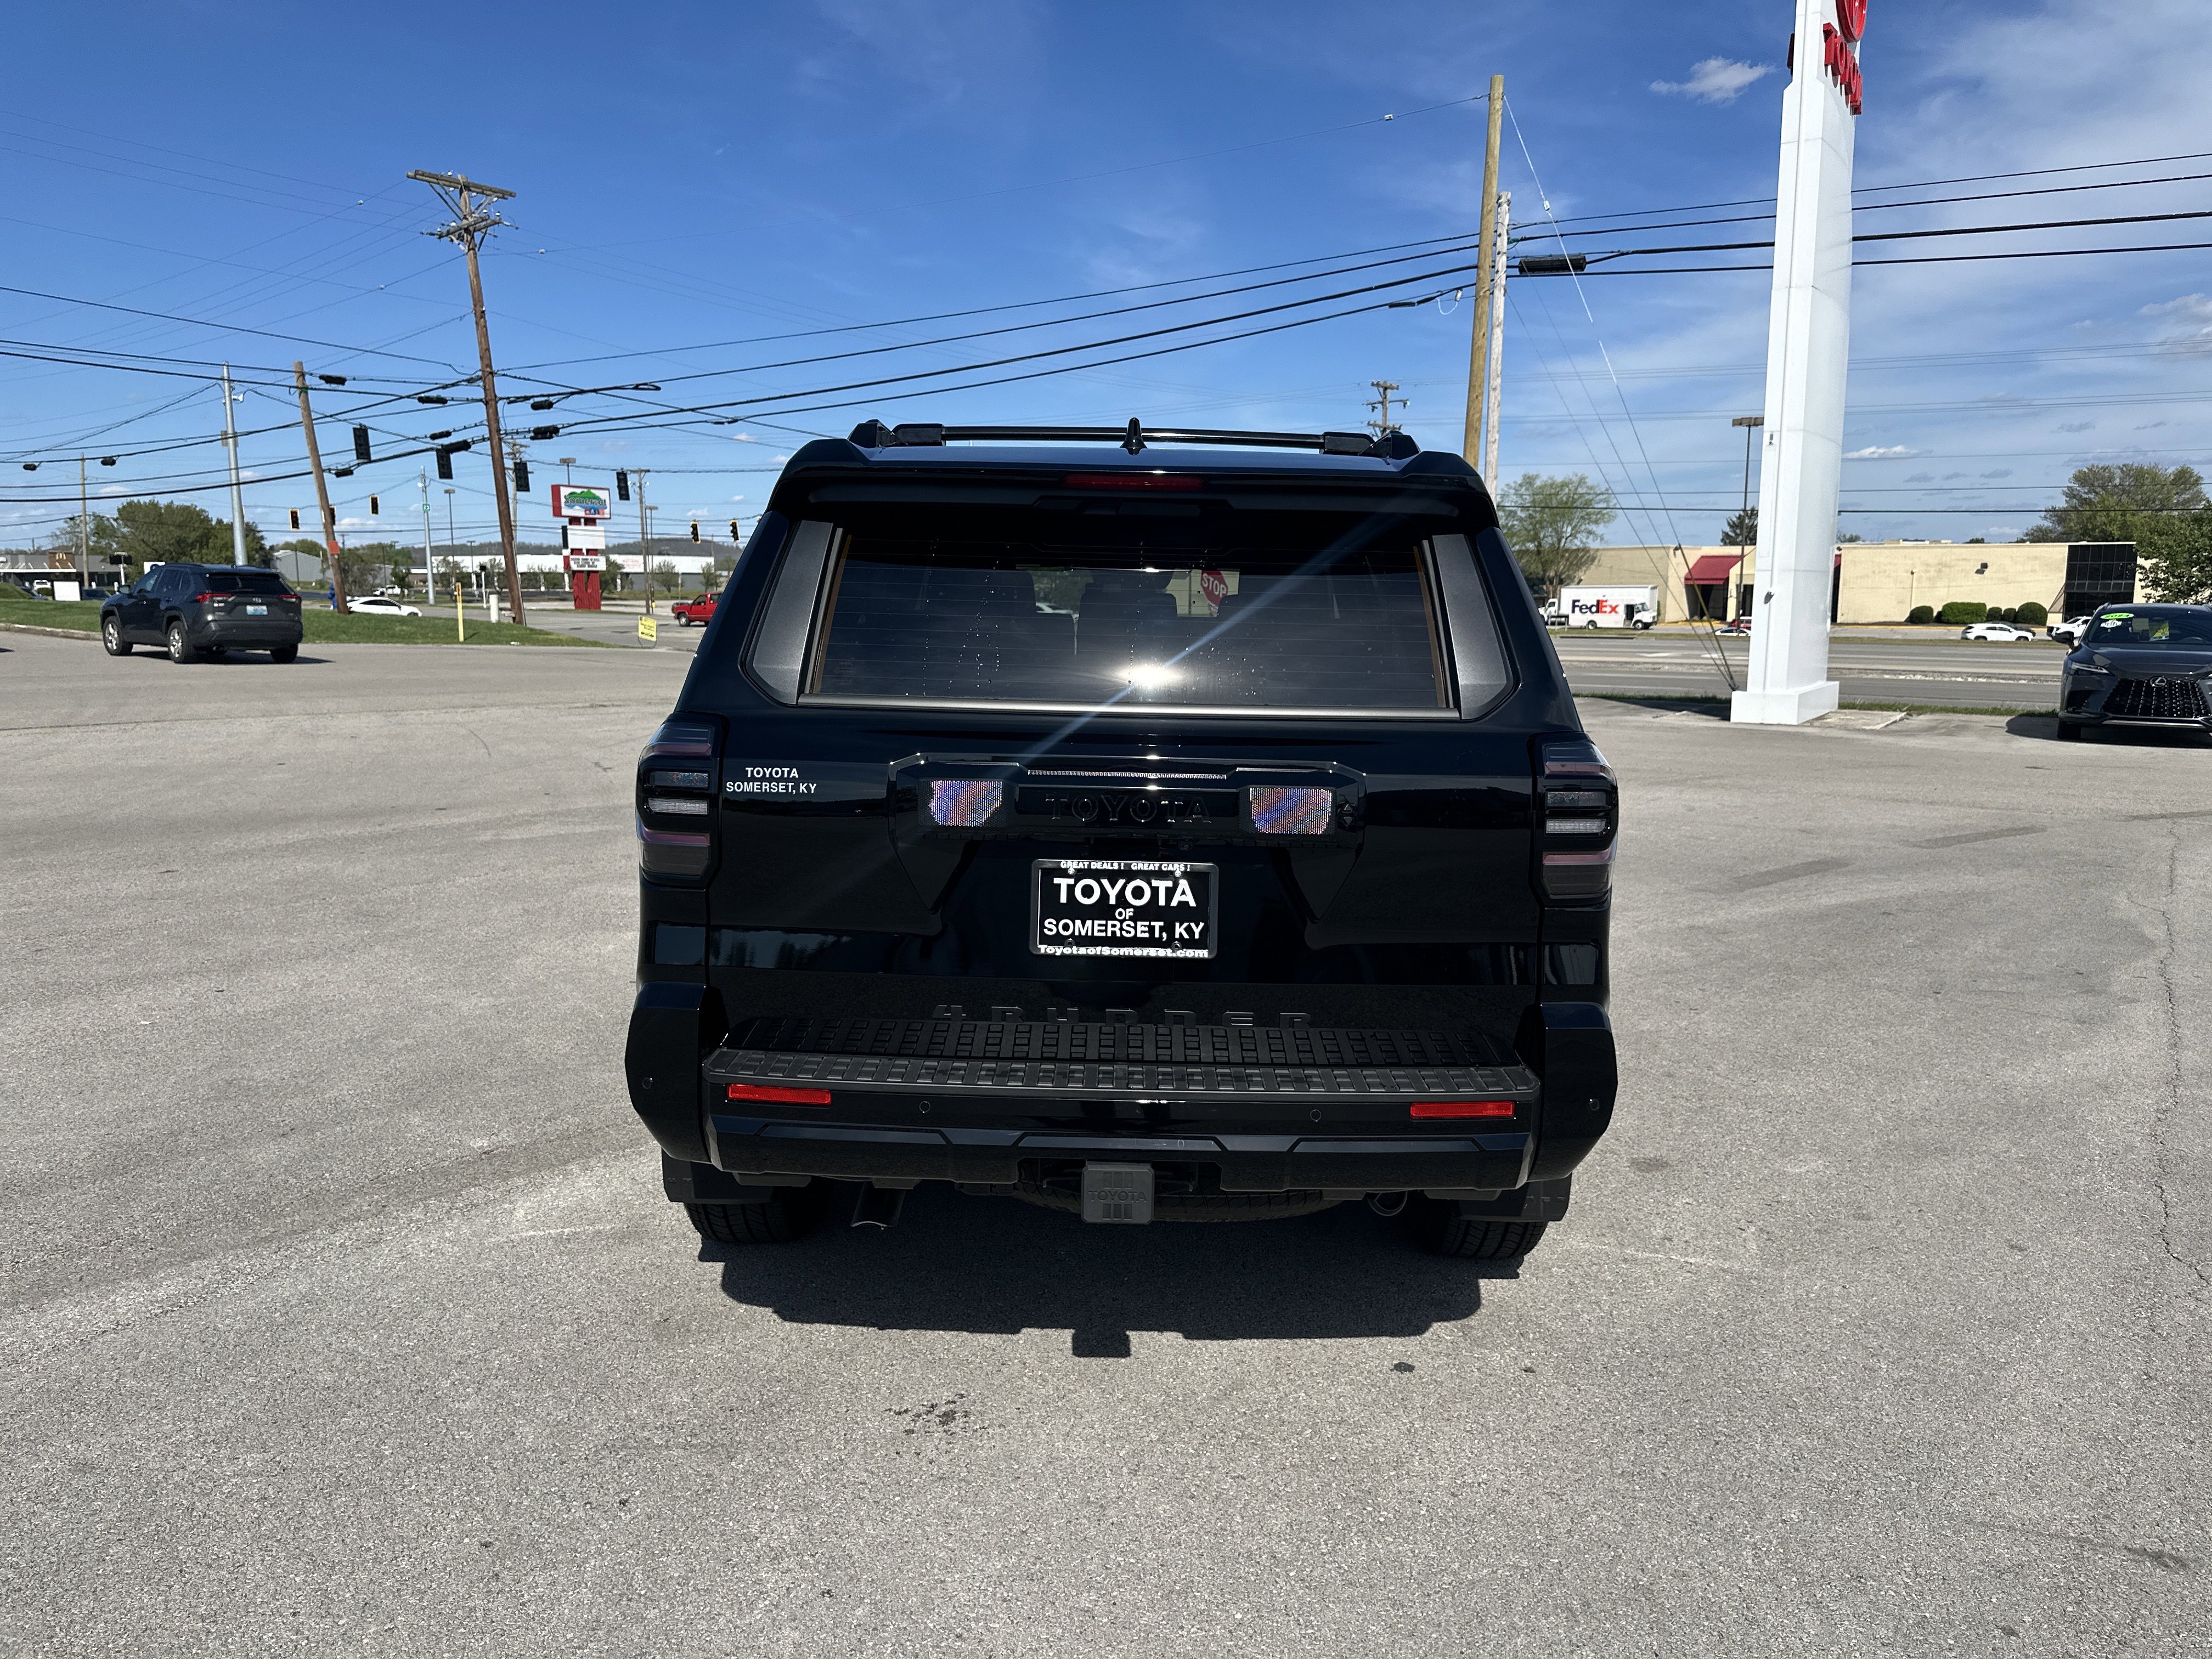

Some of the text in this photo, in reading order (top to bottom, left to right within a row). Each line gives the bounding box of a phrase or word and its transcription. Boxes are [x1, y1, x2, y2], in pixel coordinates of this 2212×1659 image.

[1201, 573, 1227, 597] STOP
[1571, 599, 1620, 614] FedEx
[745, 768, 799, 778] TOYOTA
[726, 782, 817, 795] SOMERSET, KY
[1045, 794, 1212, 823] TOYOTA
[1053, 878, 1197, 907] TOYOTA
[1115, 908, 1134, 919] OF
[1043, 918, 1205, 941] SOMERSET, KY
[1037, 945, 1208, 957] ToyotaofSomerset.com
[933, 1005, 1313, 1029] 4RUNNER
[1088, 1190, 1147, 1203] TOYOTA
